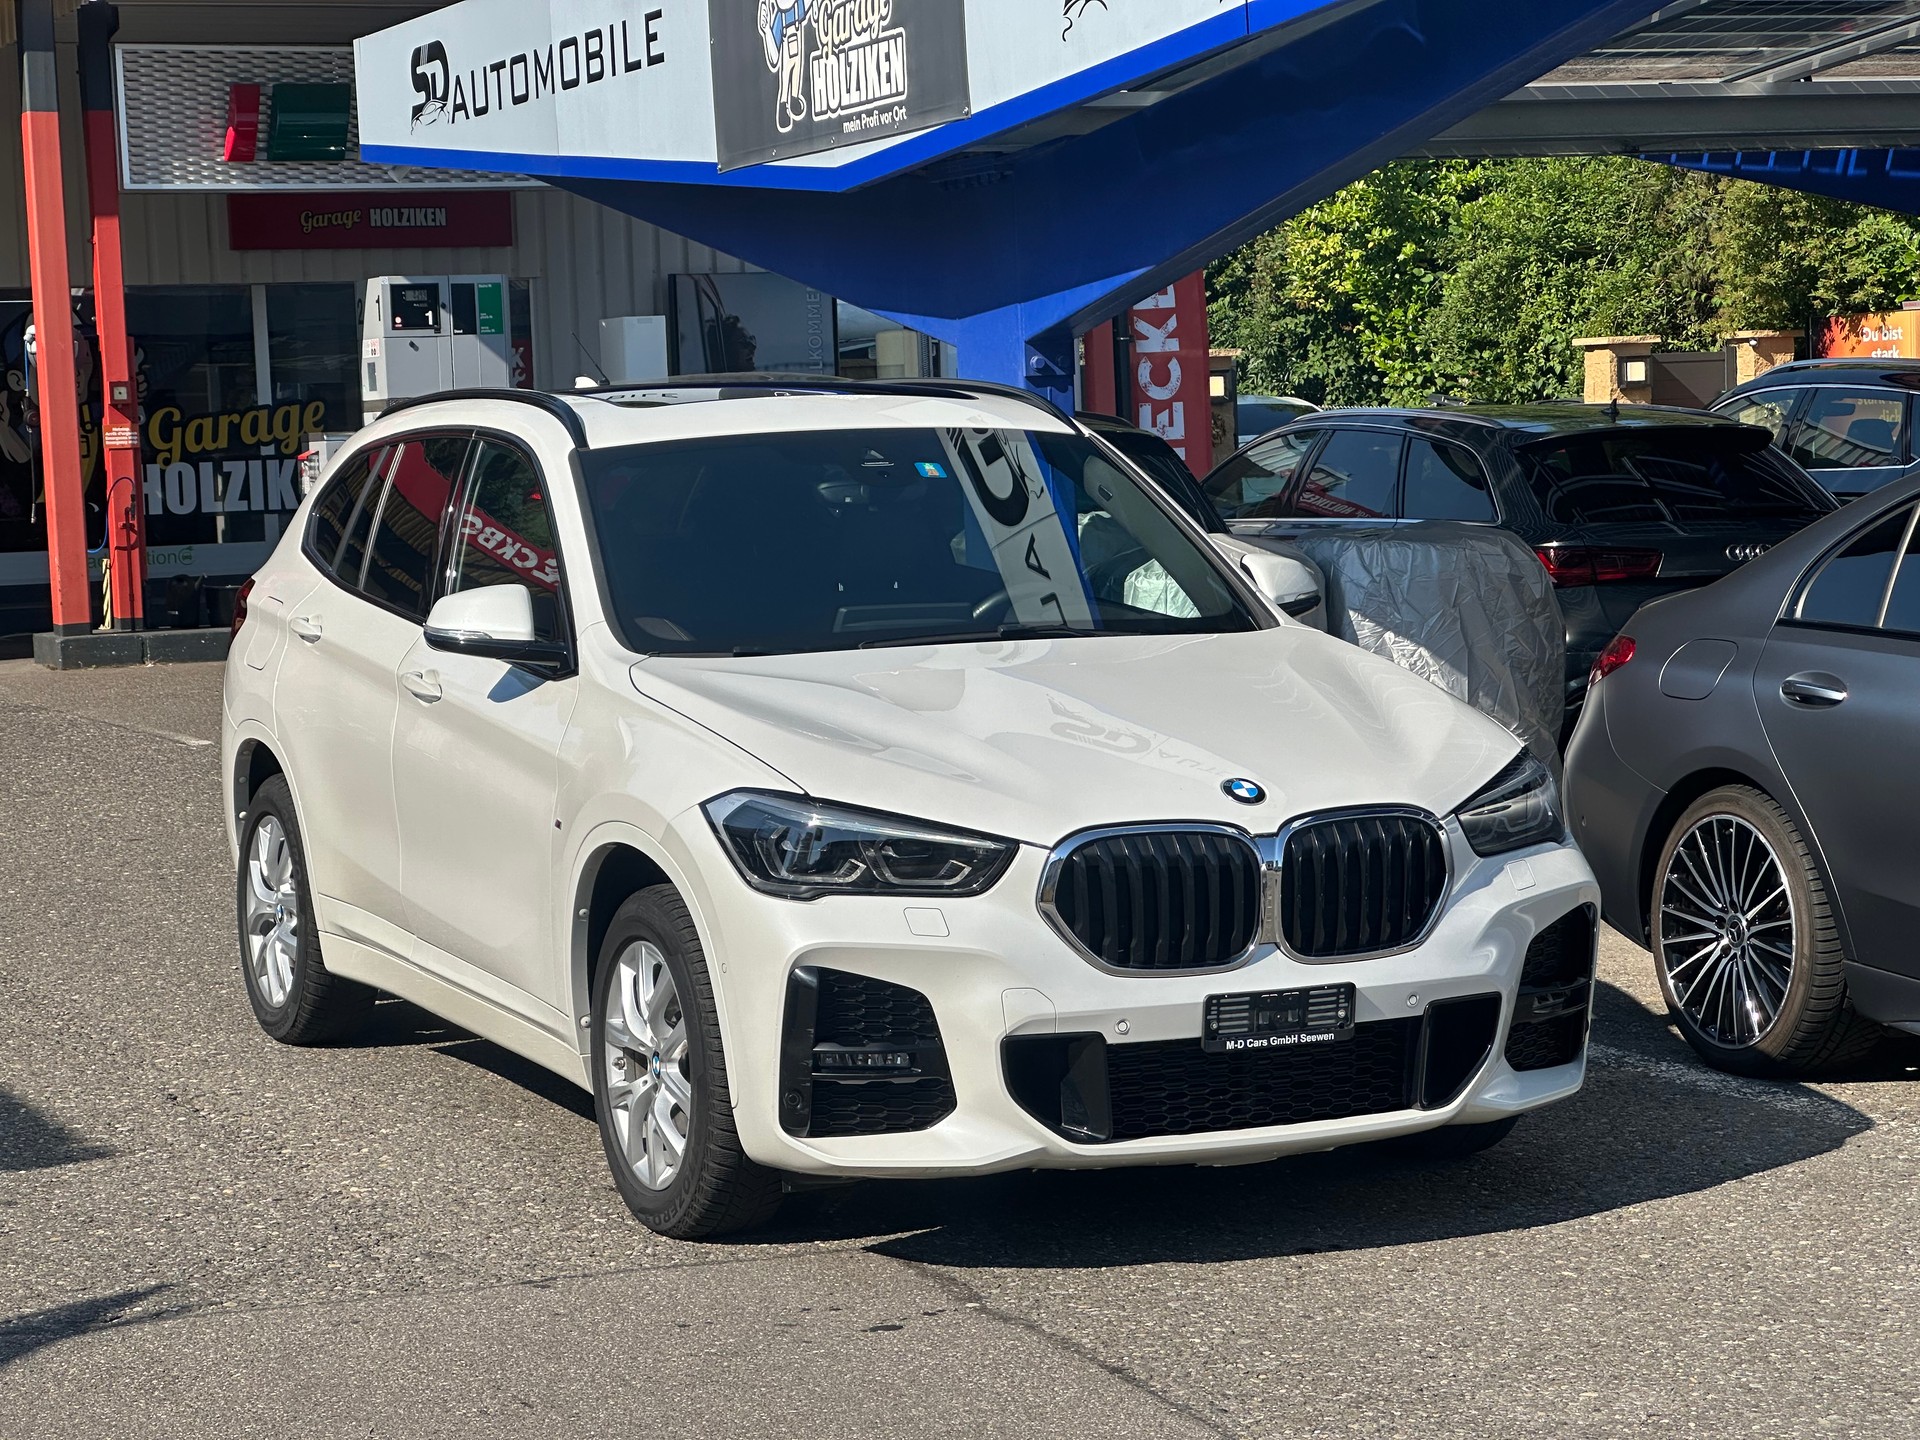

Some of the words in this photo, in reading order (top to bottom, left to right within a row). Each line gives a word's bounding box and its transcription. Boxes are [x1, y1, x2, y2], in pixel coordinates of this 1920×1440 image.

[451, 8, 665, 125] AUTOMOBILE
[812, 36, 905, 113] HOLZIKEN
[843, 116, 861, 133] mein
[861, 110, 879, 130] Profi
[880, 111, 892, 125] vor
[893, 105, 907, 122] Ort
[300, 209, 362, 234] Garage
[369, 207, 447, 227] HOLZIKEN
[376, 294, 381, 321] 1
[425, 310, 433, 325] 1
[806, 285, 825, 375] LKOMME
[1863, 327, 1879, 342] Du
[1881, 325, 1903, 341] bist
[149, 401, 325, 470] Garage
[1226, 1040, 1245, 1050] M-D
[1246, 1038, 1268, 1048] Cars
[1270, 1034, 1298, 1046] GmbH
[1300, 1032, 1335, 1043] Seewen
